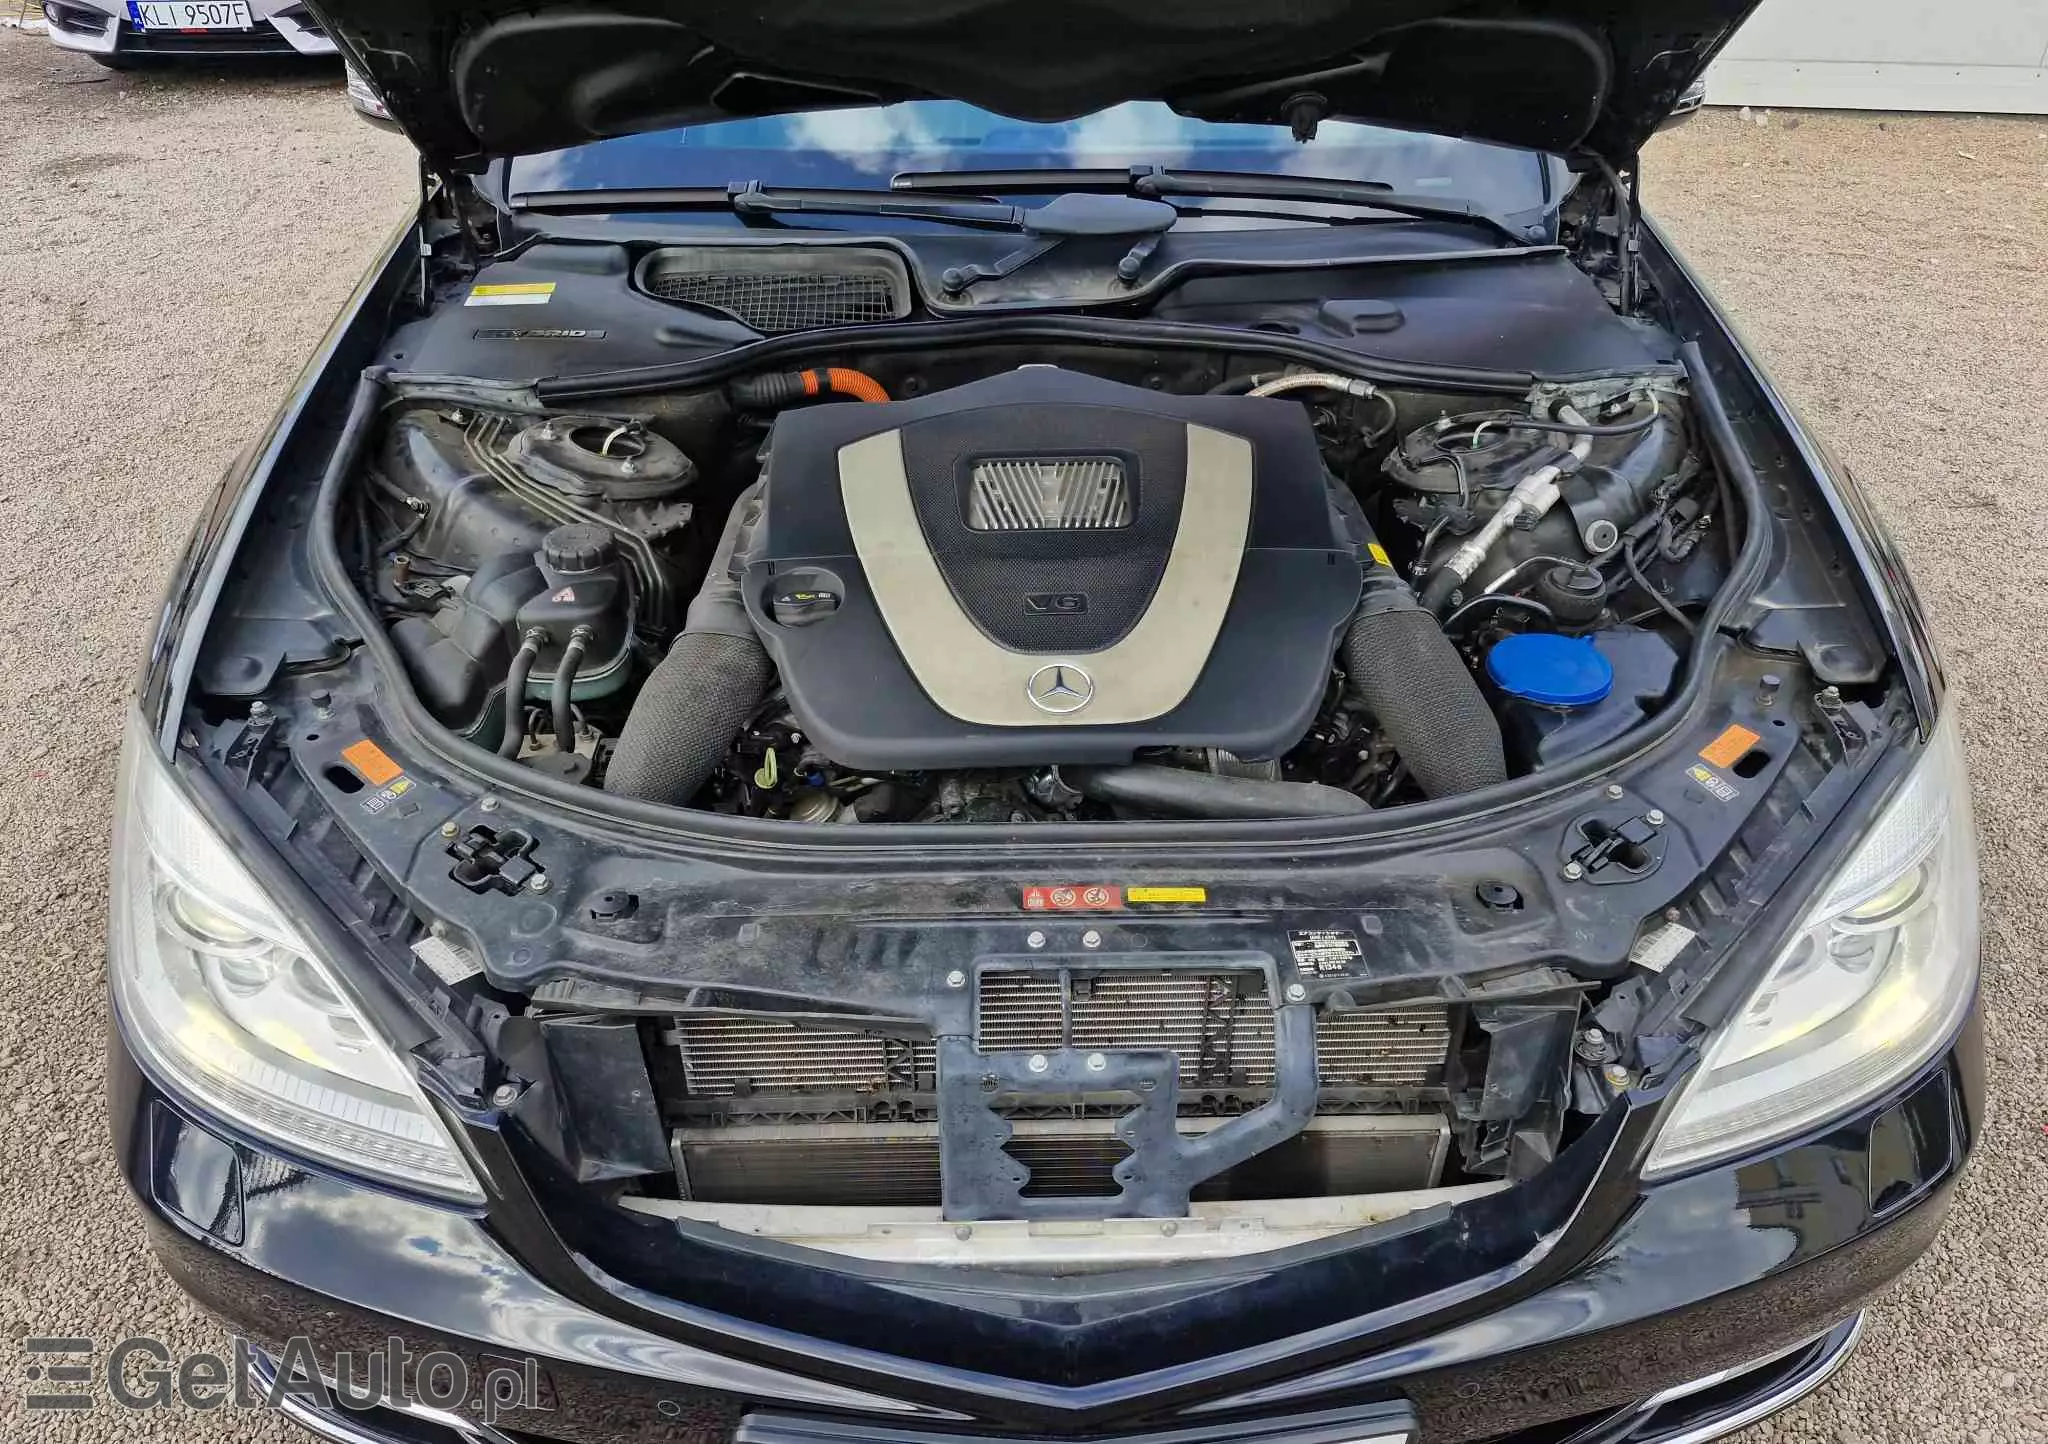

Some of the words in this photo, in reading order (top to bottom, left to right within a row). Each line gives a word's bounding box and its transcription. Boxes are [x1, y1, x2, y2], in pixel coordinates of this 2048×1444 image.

[140, 5, 177, 26] KLI
[185, 3, 244, 25] 9507F
[1027, 597, 1079, 611] V6
